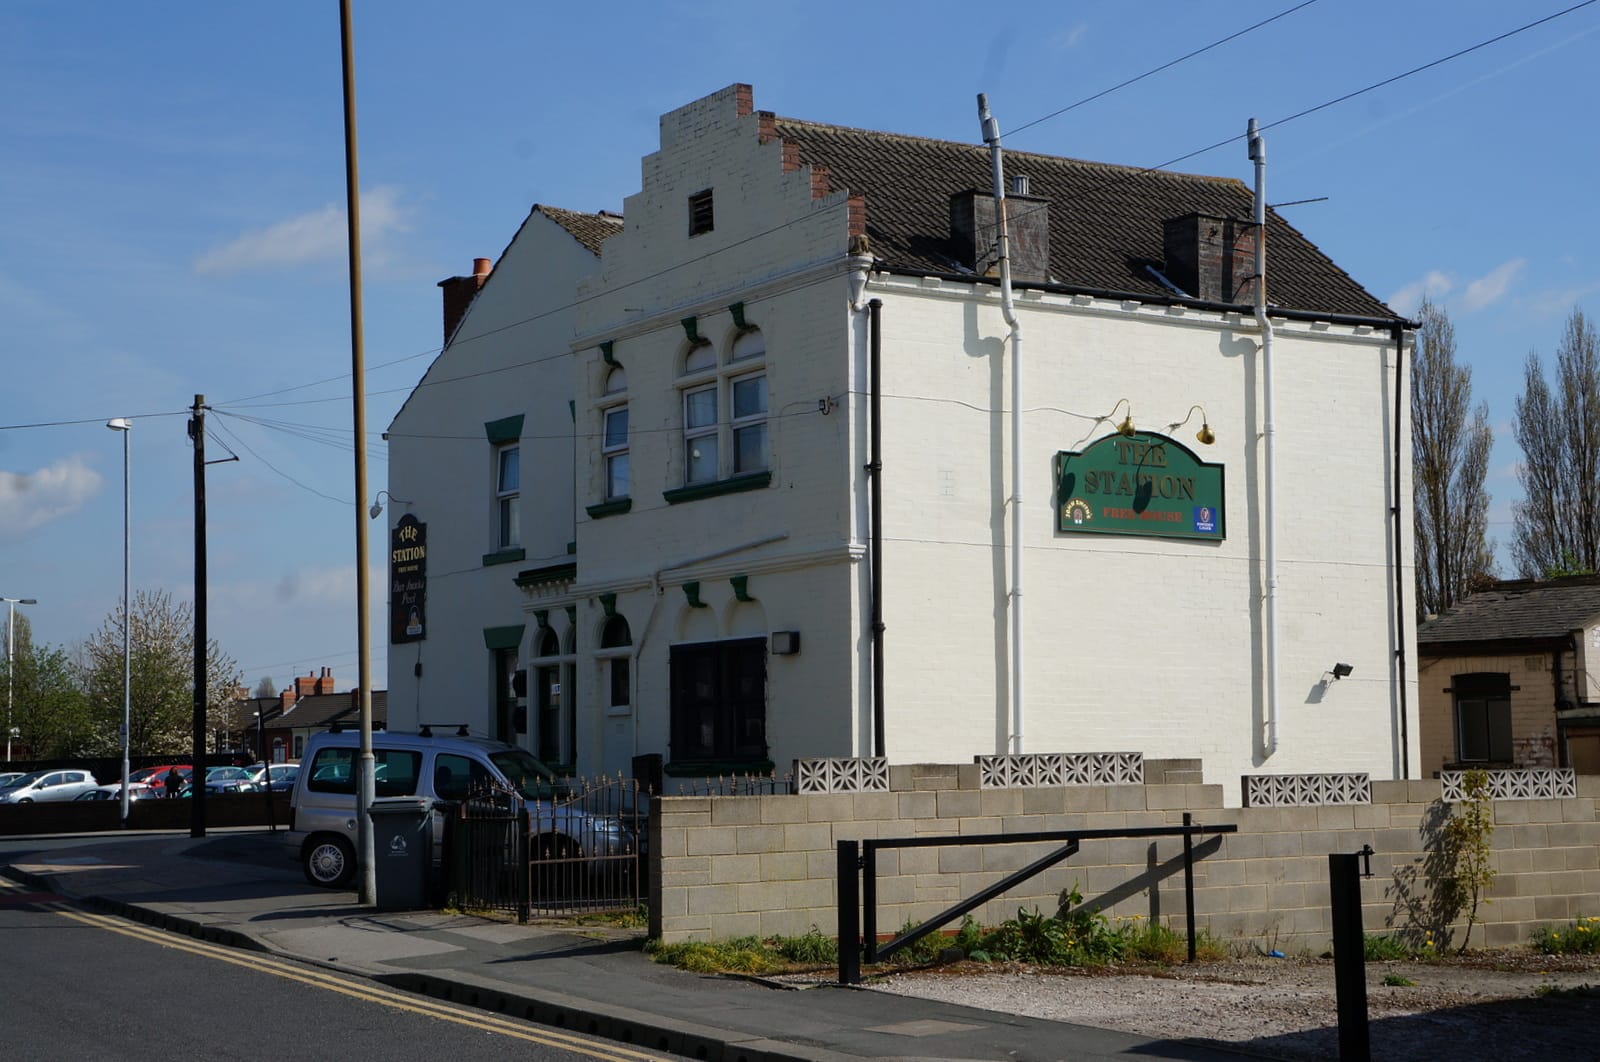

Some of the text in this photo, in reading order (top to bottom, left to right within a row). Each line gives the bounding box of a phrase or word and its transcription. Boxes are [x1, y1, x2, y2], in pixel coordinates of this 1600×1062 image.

[1115, 441, 1168, 468] THE
[1084, 470, 1196, 501] STATION
[1103, 507, 1136, 520] FREE
[399, 525, 418, 543] THE
[392, 545, 425, 563] STATION
